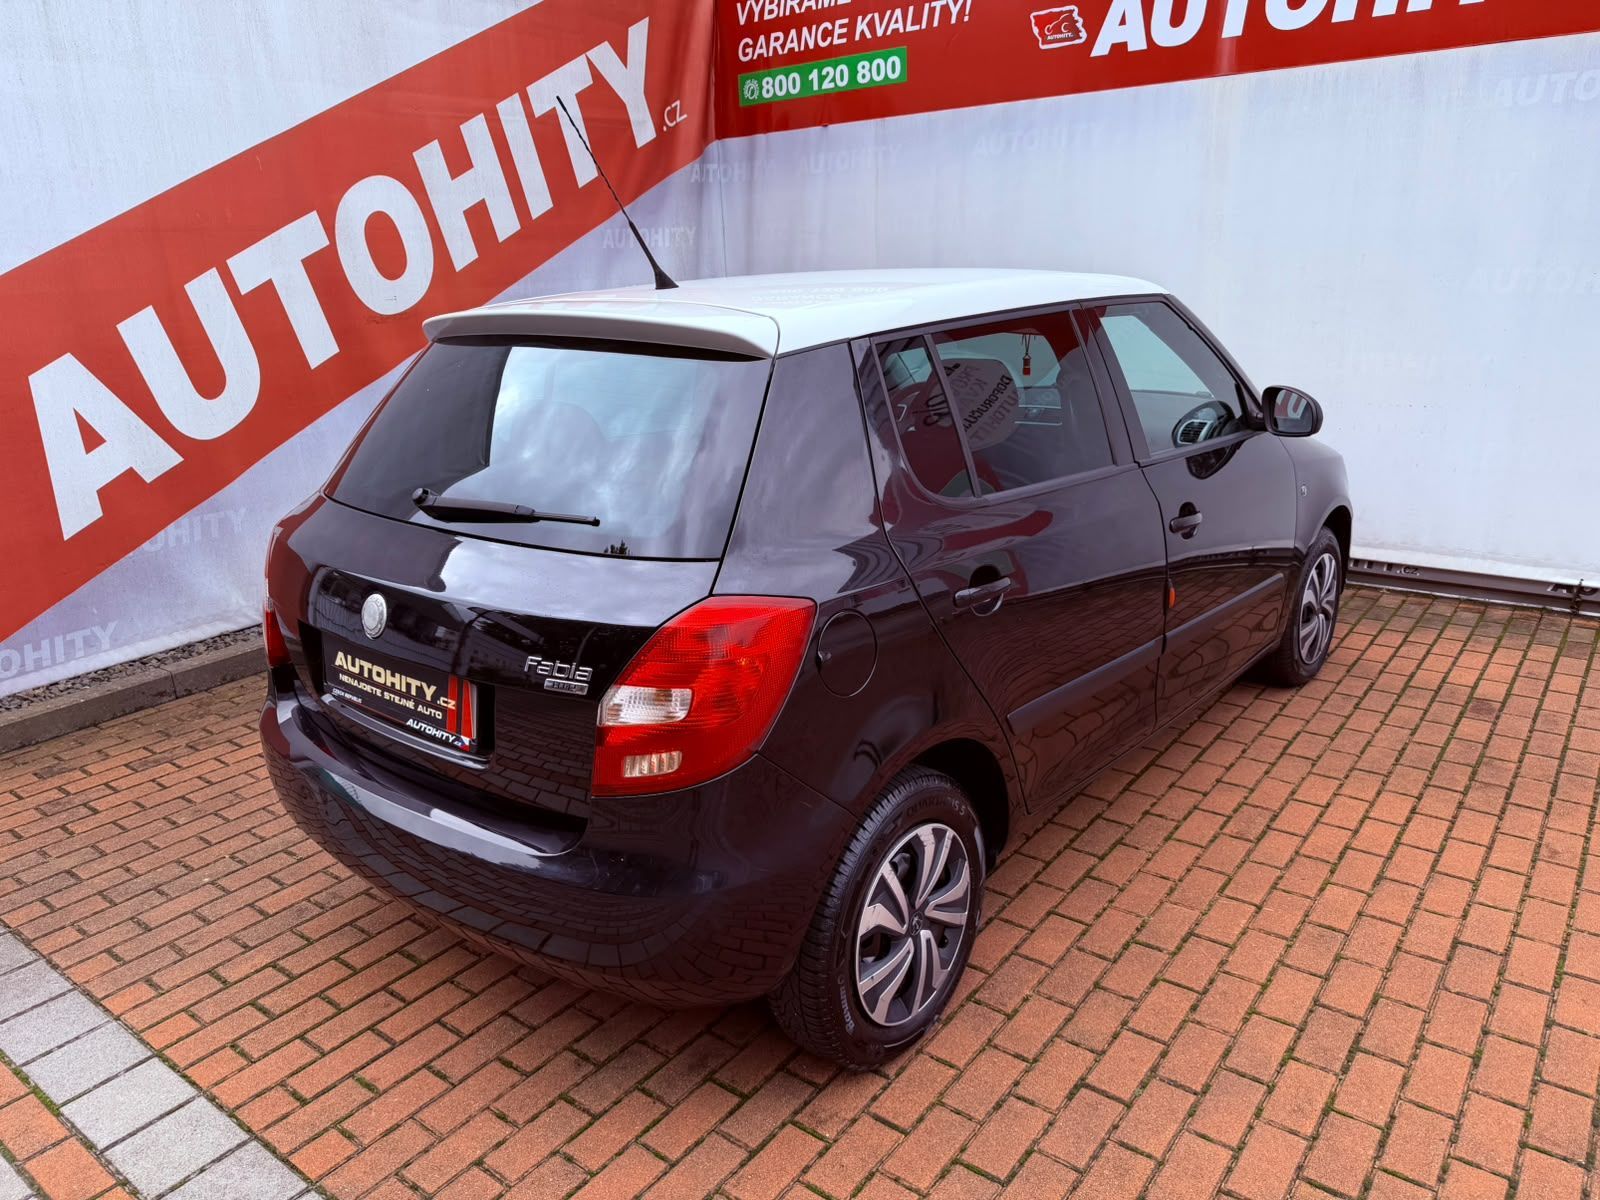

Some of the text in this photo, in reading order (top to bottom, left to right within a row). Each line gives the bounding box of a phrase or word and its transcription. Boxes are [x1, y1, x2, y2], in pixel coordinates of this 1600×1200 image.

[738, 0, 972, 62] GARANCE KVALITY!
[762, 55, 901, 98] 800 120 800
[523, 655, 593, 682] Fabia
[339, 673, 443, 719] NENAJDETE STEJNÉ AUTO
